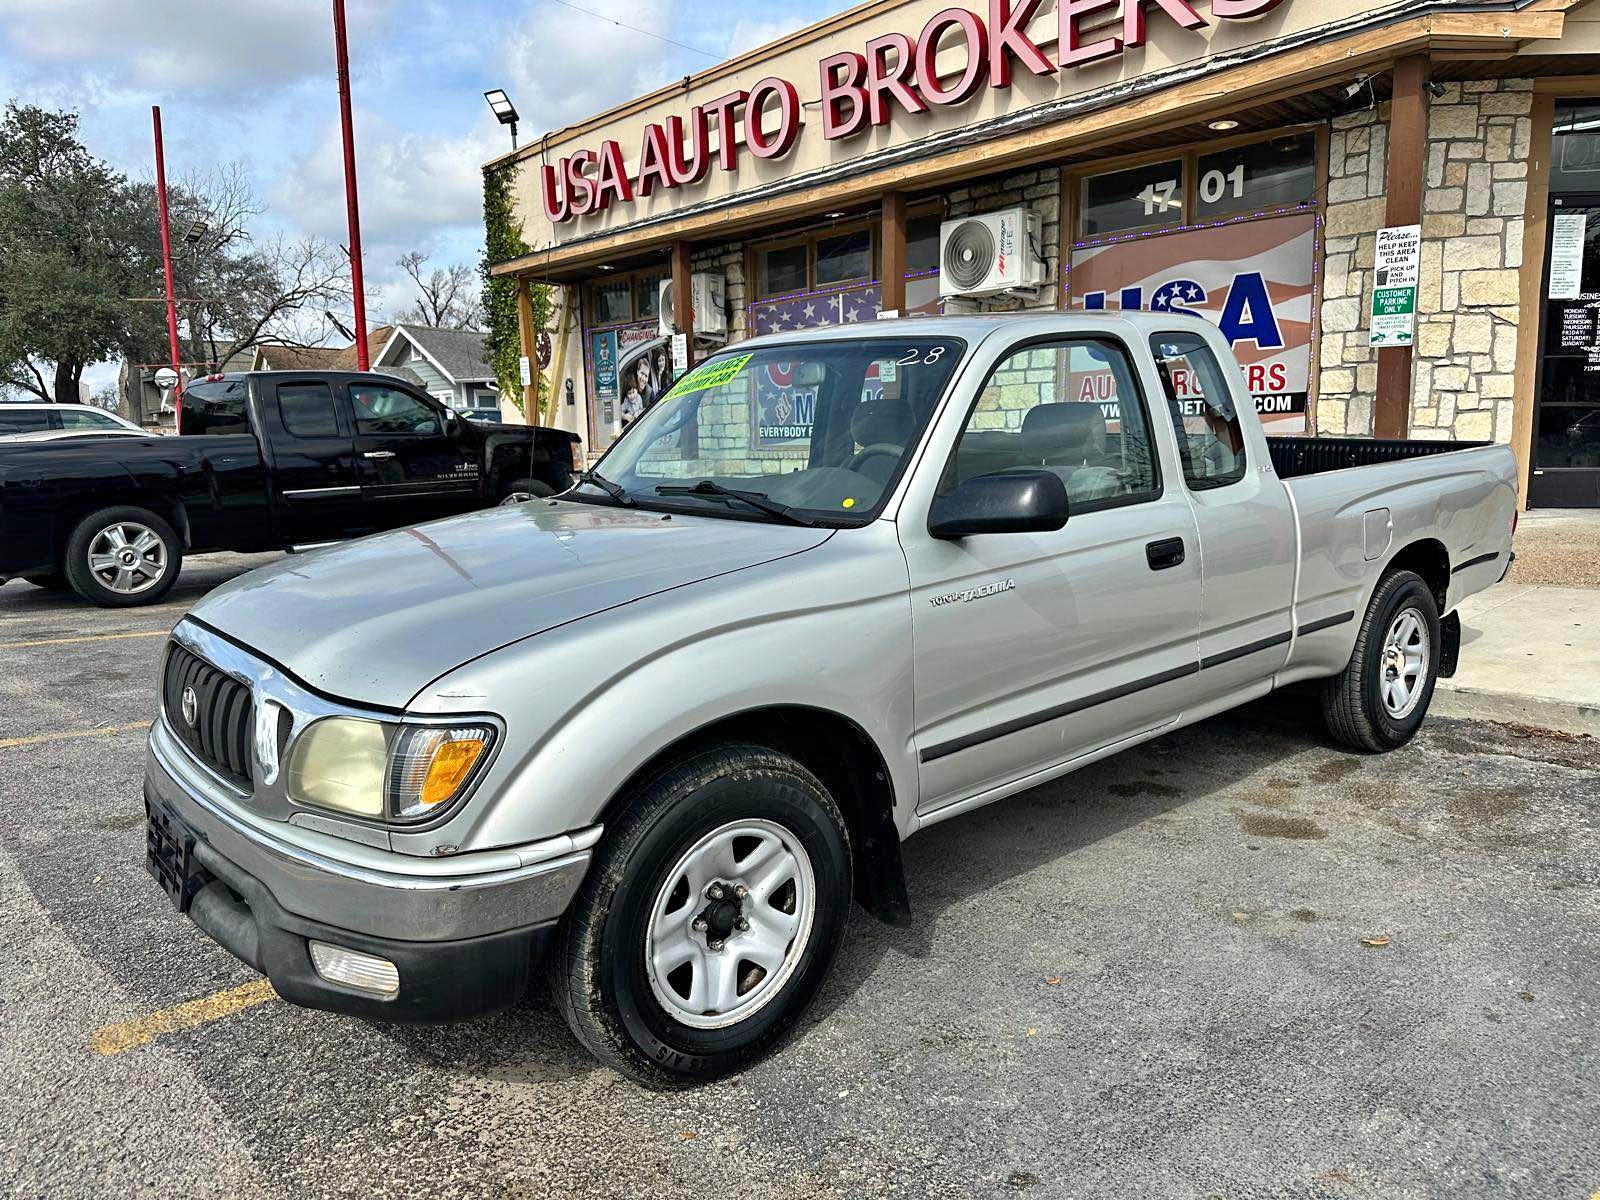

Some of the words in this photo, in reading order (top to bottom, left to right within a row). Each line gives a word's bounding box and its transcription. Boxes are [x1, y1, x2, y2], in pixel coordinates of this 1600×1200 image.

[540, 140, 632, 223] USA
[637, 76, 800, 197] AUTO
[818, 0, 1287, 141] BROKE
[1135, 179, 1178, 217] 17
[1199, 164, 1245, 204] 01
[1378, 241, 1397, 251] HELP
[1398, 240, 1418, 248] KEEP
[1379, 248, 1395, 257] THIS
[1396, 247, 1416, 256] AREA
[1385, 256, 1409, 264] CLEAN
[1389, 277, 1407, 285] PITCH
[1376, 288, 1412, 299] CUSTOMER
[1379, 297, 1408, 306] PARKING
[1383, 305, 1402, 314] ONLY
[896, 346, 946, 367] 28
[709, 369, 737, 385] CAR
[759, 426, 806, 438] EVERYBODY
[960, 577, 1016, 603] TACOMA
